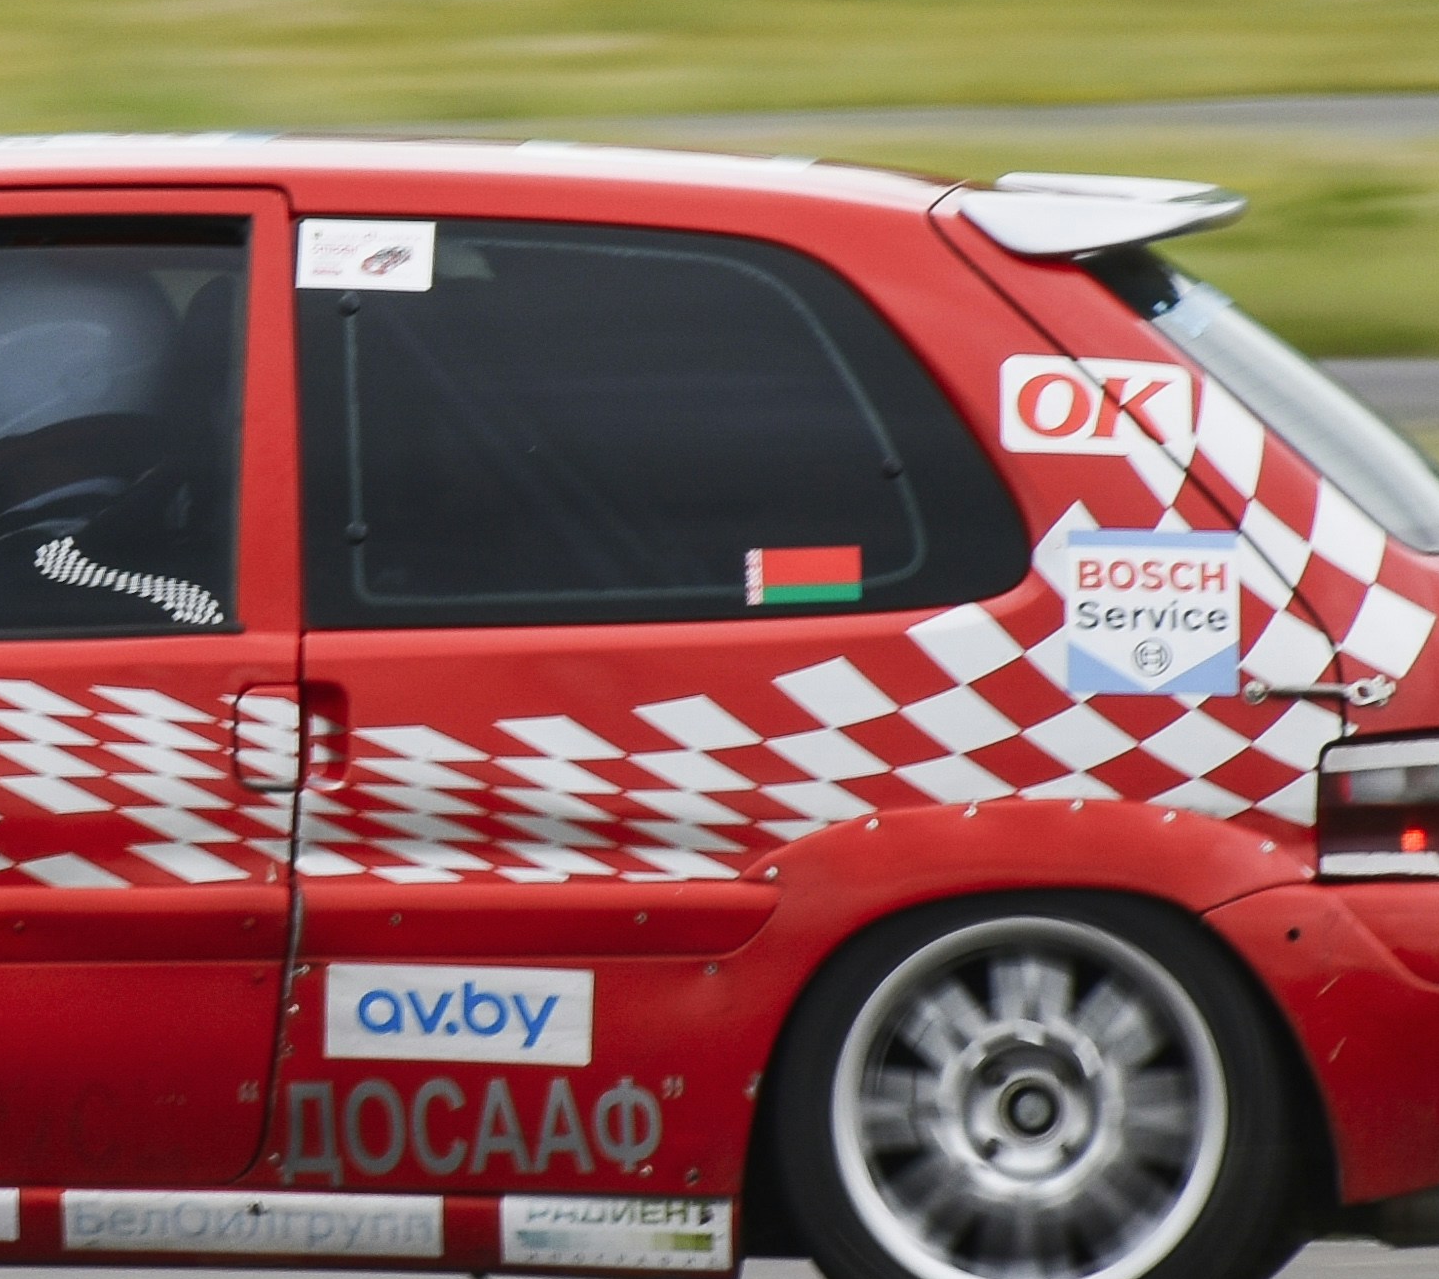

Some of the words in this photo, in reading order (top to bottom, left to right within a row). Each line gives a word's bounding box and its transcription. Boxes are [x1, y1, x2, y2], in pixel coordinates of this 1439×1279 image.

[1017, 373, 1169, 445] OK
[1077, 560, 1227, 592] BOSCH
[1075, 599, 1229, 633] Service
[357, 982, 559, 1049] av.by
